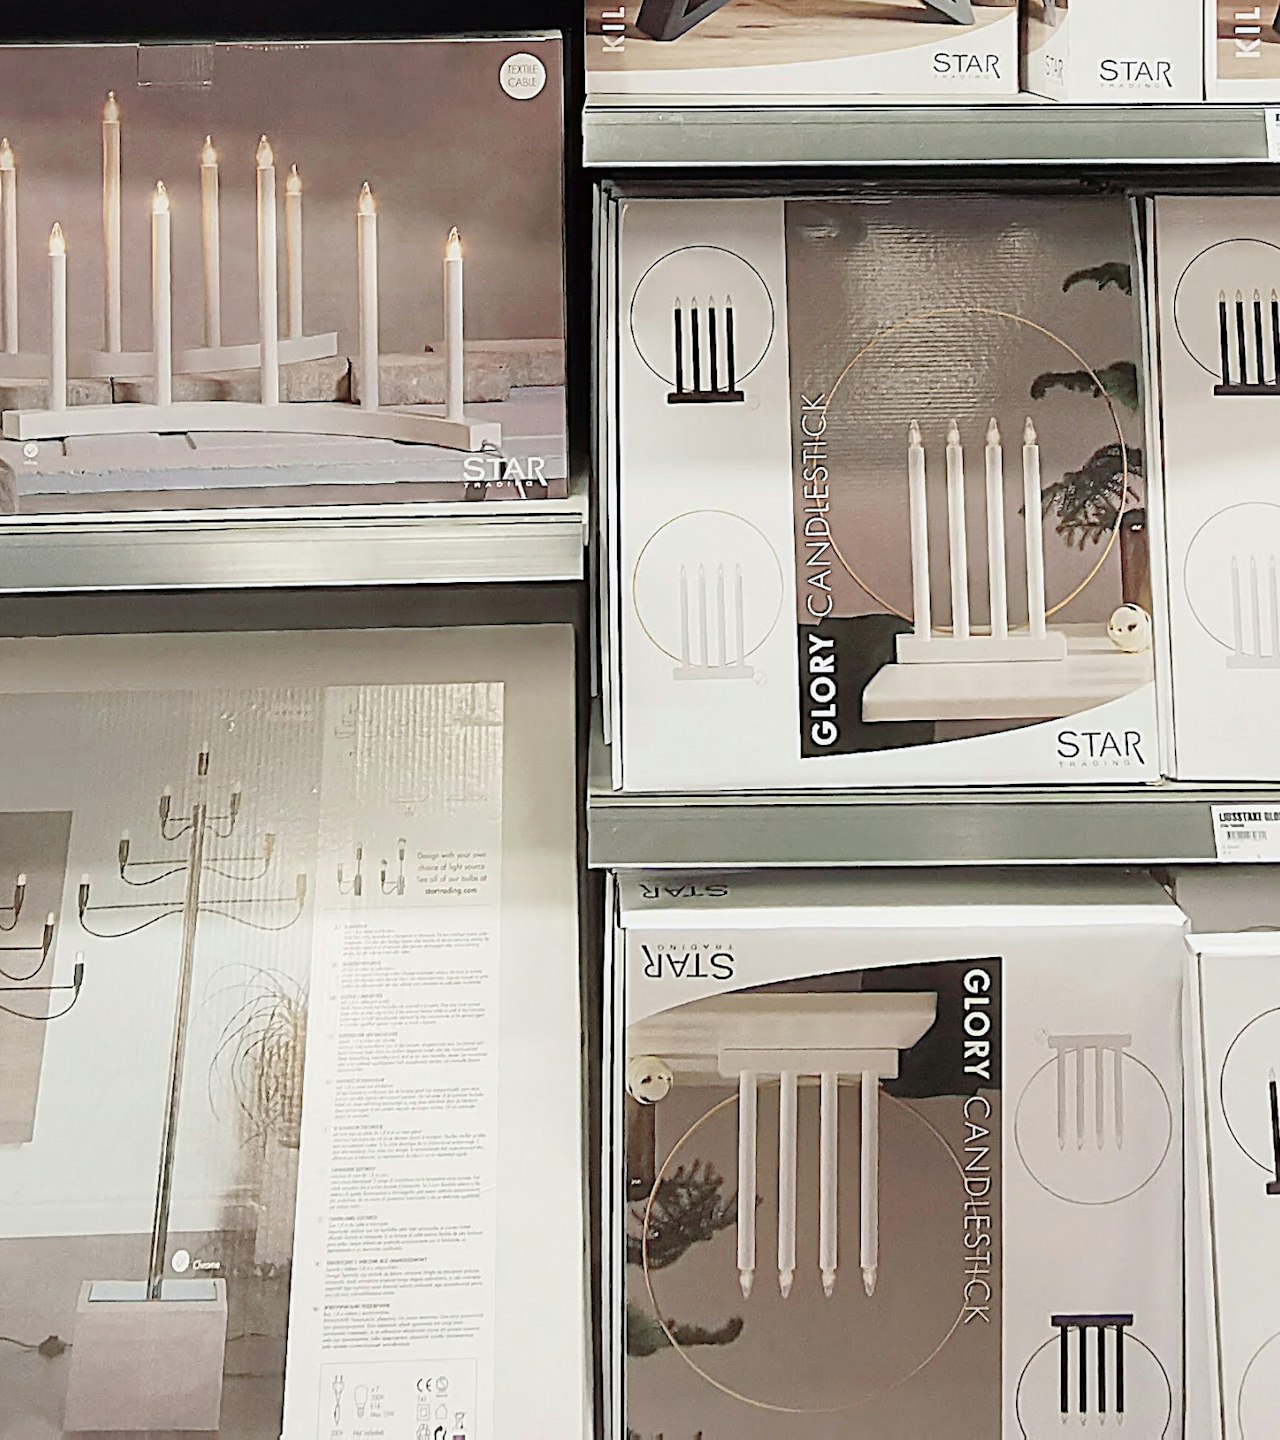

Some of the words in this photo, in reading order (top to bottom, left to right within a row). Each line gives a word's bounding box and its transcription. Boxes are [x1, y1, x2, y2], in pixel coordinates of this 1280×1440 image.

[601, 5, 625, 53] KIL
[1235, 6, 1261, 59] KIL
[507, 64, 538, 74] TEXTILE
[508, 77, 536, 87] CABLE
[932, 52, 1001, 79] STAR
[1100, 59, 1172, 87] STAR
[463, 457, 548, 486] STAR
[801, 393, 833, 618] CANDLESTICK
[810, 634, 838, 748] GLORY
[1056, 731, 1144, 765] STAR
[640, 884, 728, 898] STAR
[641, 945, 735, 980] STAR
[962, 968, 991, 1080] GLORY
[962, 1096, 992, 1324] CANDLESTICK
